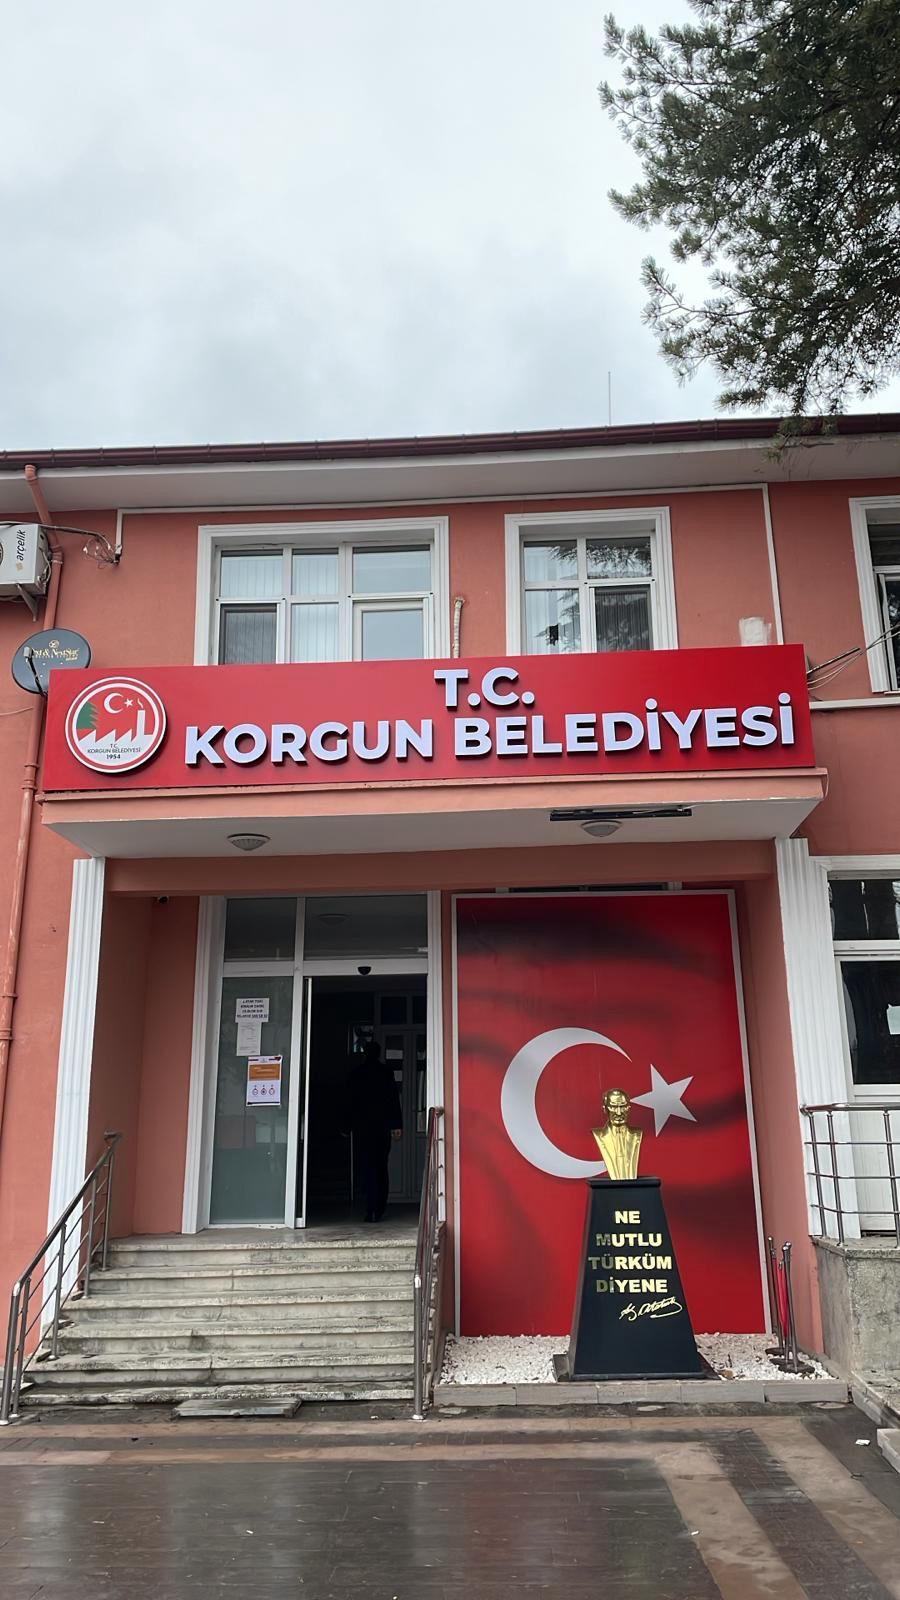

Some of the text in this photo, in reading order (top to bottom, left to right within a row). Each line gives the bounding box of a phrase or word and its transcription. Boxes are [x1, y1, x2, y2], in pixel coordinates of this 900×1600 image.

[16, 530, 26, 561] arçelik
[434, 667, 535, 707] T.C.
[185, 692, 794, 764] KORGUN BELEDİYESİ
[615, 1210, 641, 1224] NE
[596, 1233, 662, 1247] MUTLU
[588, 1253, 672, 1270] TÜRKÜM
[596, 1276, 668, 1293] DİYENE
